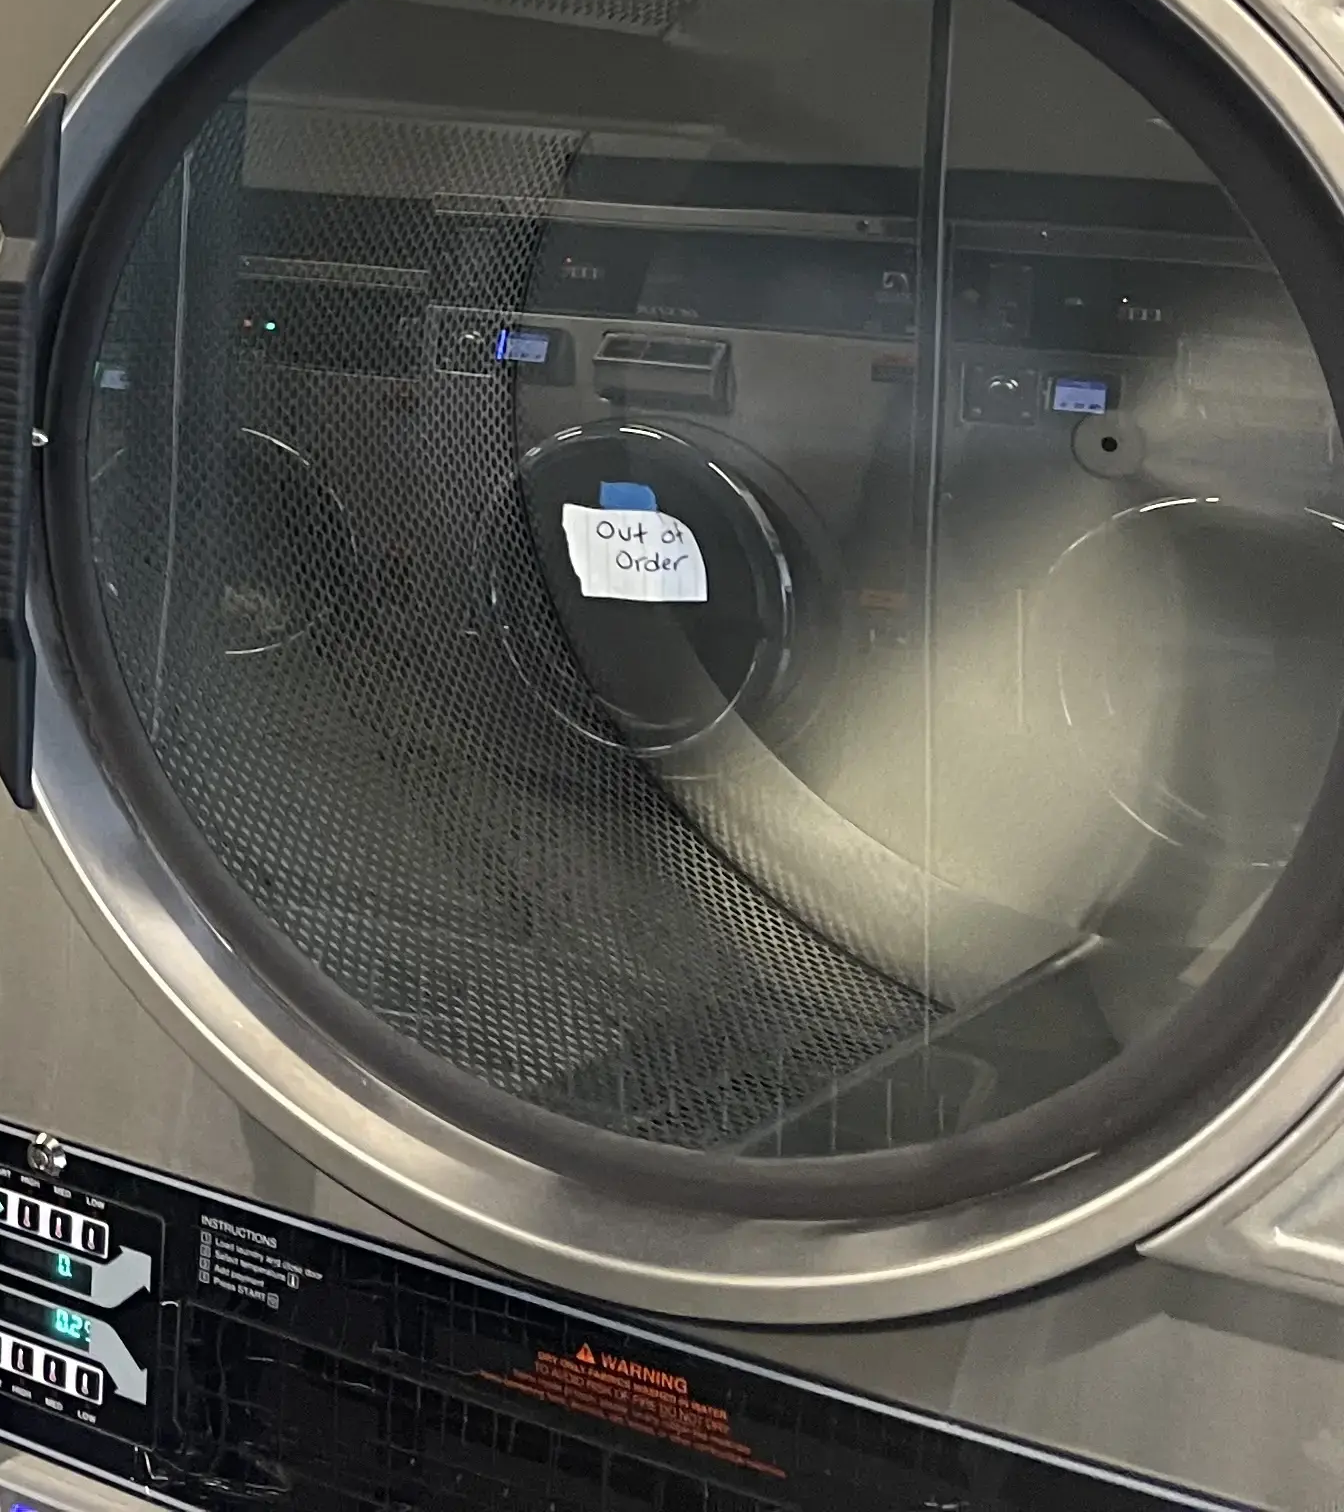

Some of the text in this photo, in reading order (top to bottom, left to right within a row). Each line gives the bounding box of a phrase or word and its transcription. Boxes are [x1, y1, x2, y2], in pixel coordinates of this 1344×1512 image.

[595, 520, 649, 545] Out
[615, 550, 689, 572] Order
[200, 1213, 278, 1249] INSTRUCTIONS
[600, 1351, 689, 1394] WARNING
